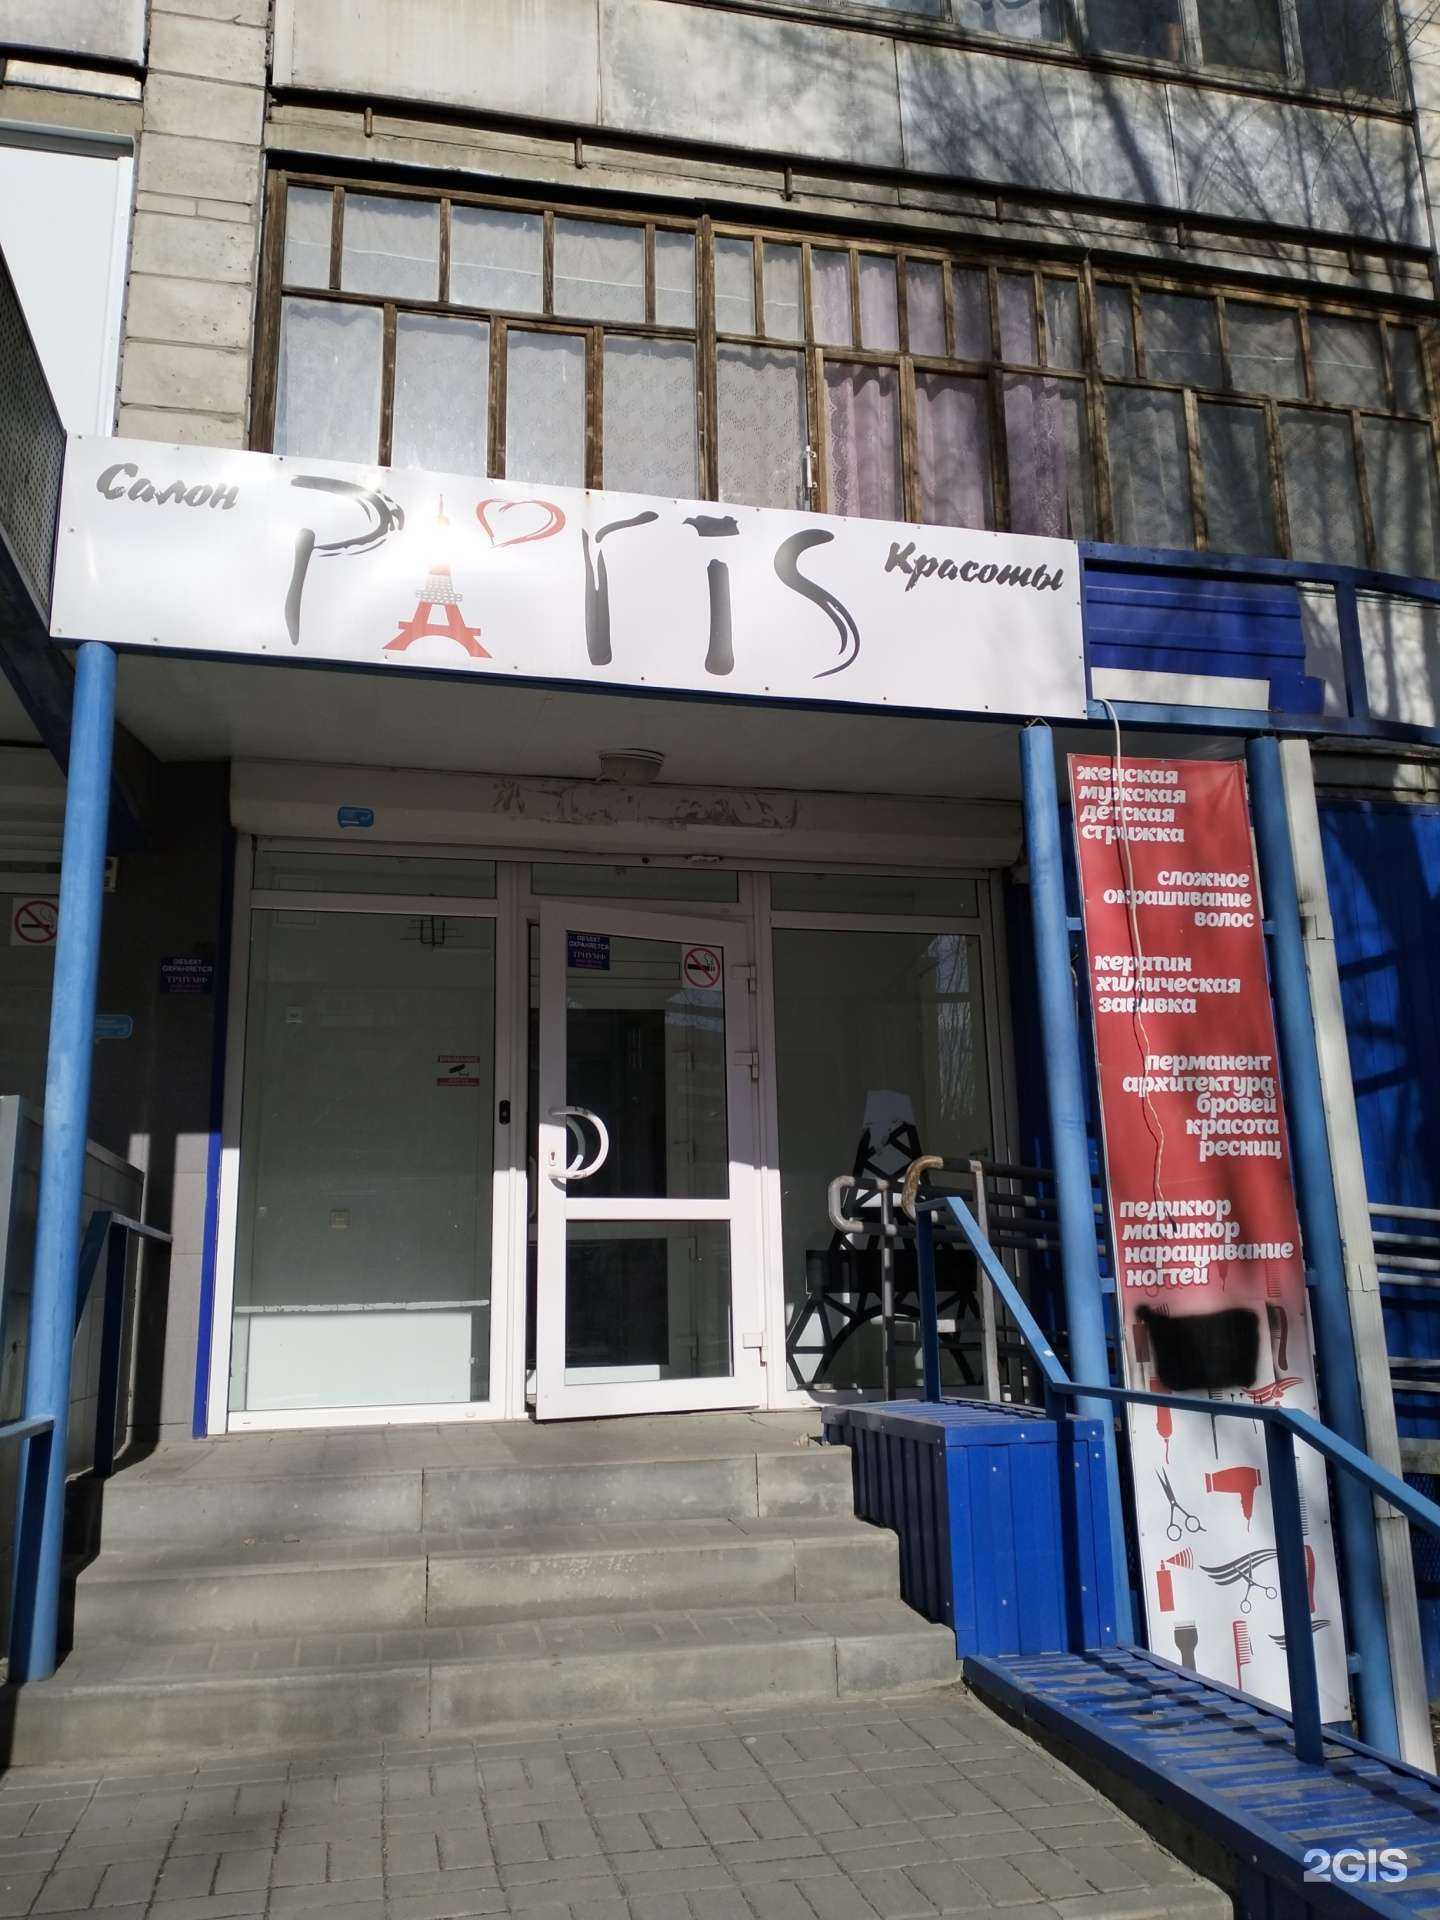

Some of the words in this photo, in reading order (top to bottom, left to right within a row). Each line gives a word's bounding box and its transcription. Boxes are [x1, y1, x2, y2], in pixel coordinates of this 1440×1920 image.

[96, 462, 242, 511] Салон
[883, 541, 1064, 593] Красоты
[1076, 766, 1179, 784] женская
[1078, 785, 1187, 805] мужская
[1079, 805, 1175, 823] детская
[1081, 824, 1186, 845] стрижка
[1157, 870, 1250, 888] сложное
[1103, 889, 1252, 908] окрашивание
[1194, 911, 1254, 927] волос
[1094, 955, 1193, 977] кератин
[1095, 976, 1242, 994] химическая
[1098, 997, 1198, 1014] завивка
[1145, 1055, 1273, 1076] перманент
[1122, 1076, 1276, 1098] архитектура
[1196, 1093, 1277, 1118] бровей
[1185, 1118, 1280, 1141] красота
[1199, 1140, 1283, 1163] ресниц
[1119, 1199, 1233, 1222] педикюр
[1121, 1221, 1241, 1244] маникюр
[1124, 1241, 1295, 1268] наращивание
[1126, 1266, 1209, 1287] ногтей
